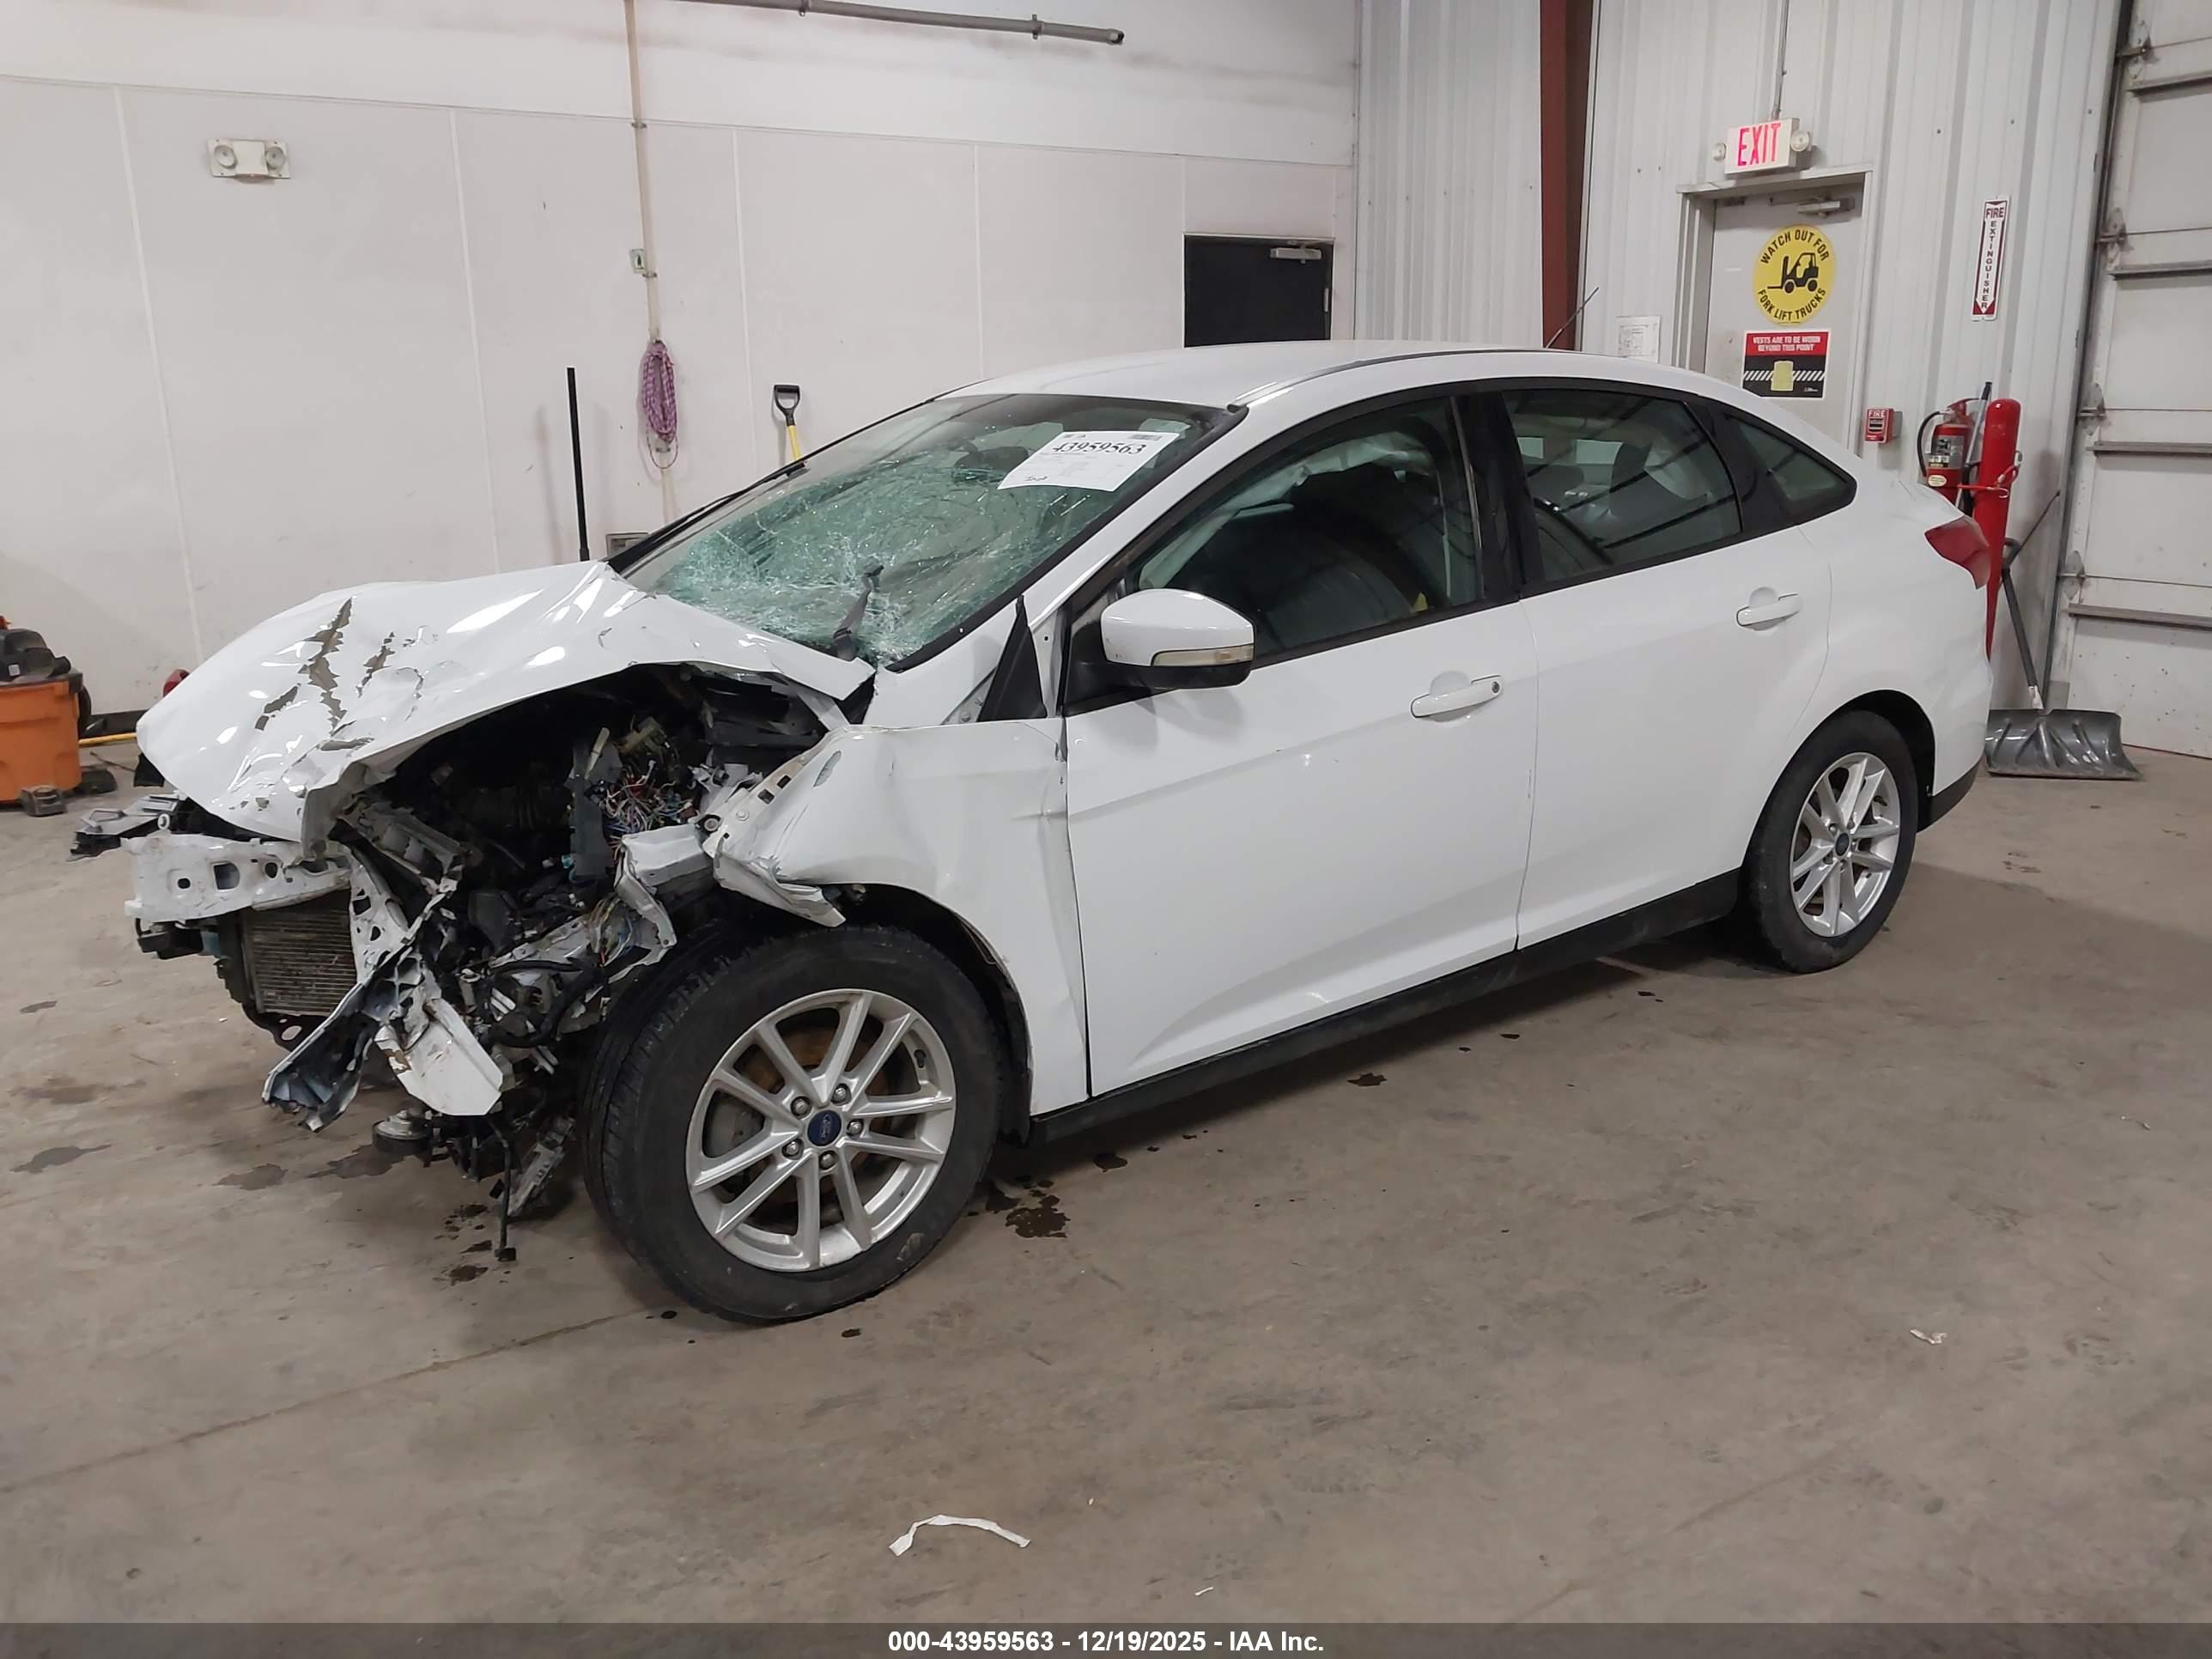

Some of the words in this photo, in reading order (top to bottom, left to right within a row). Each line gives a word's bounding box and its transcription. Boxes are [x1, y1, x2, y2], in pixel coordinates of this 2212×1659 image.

[1737, 123, 1781, 167] EXIT
[1985, 207, 2005, 219] FIRE
[1760, 231, 1791, 264] WATCH
[1795, 228, 1814, 243] OUT
[1814, 239, 1830, 262] FOR
[1981, 220, 1997, 309] EXTINGUISHER
[1757, 289, 1774, 315] FORK
[1774, 307, 1793, 321] LIFT
[1795, 287, 1827, 319] TRUCKS
[1869, 410, 1886, 418] FIRE
[1052, 441, 1148, 455] 43959563
